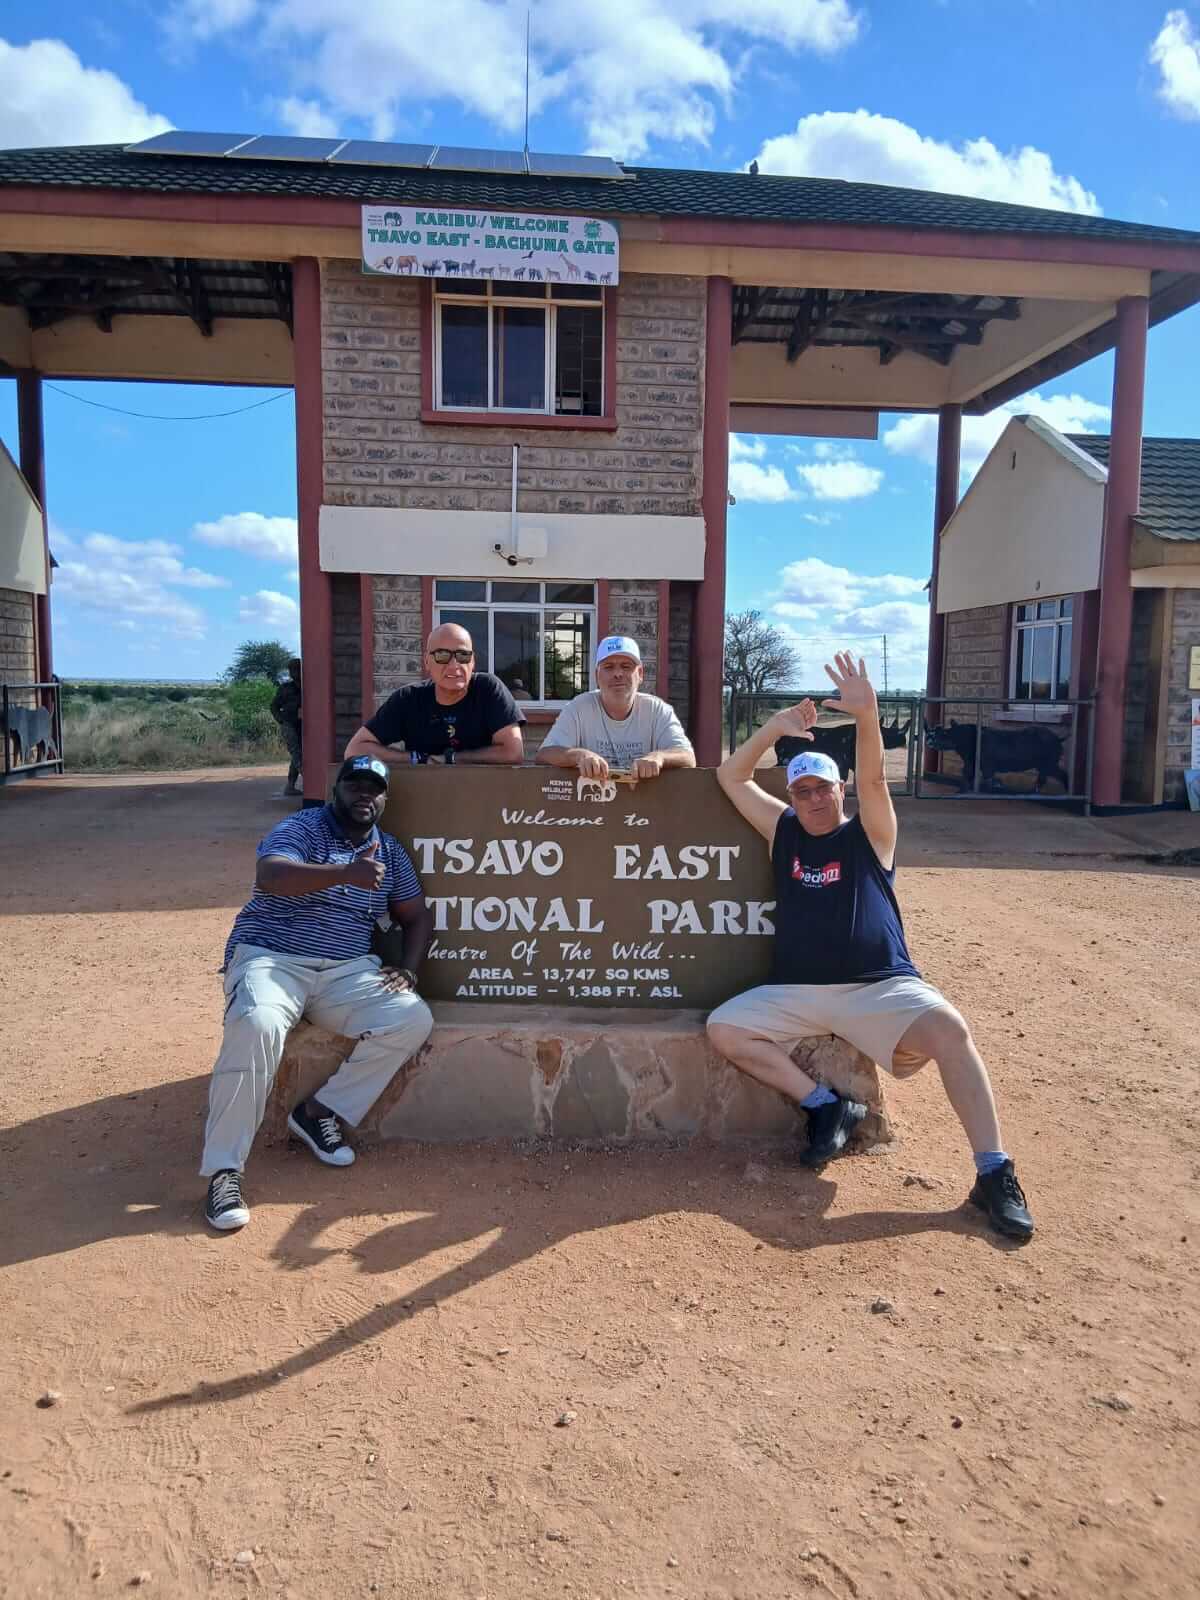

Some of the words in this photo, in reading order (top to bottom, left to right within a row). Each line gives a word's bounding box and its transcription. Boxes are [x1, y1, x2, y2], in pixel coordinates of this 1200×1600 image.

[367, 228, 421, 245] TSAVO
[426, 231, 470, 248] EAST
[573, 240, 616, 255] GATE
[501, 807, 605, 827] Welcome
[623, 812, 649, 827] to
[412, 837, 564, 876] TSAVO
[613, 843, 741, 881] EAST
[376, 896, 605, 933] TIONAL
[646, 899, 777, 935] PARK
[426, 938, 488, 961] heatre
[511, 938, 540, 966] Of
[559, 940, 592, 961] The
[467, 967, 514, 981] AREA
[542, 968, 596, 982] 13,747
[605, 968, 630, 981] SQ
[633, 968, 670, 981] KMS
[455, 984, 538, 997] ALTITUDE
[616, 986, 641, 998] FT.
[650, 986, 683, 998] ASL
